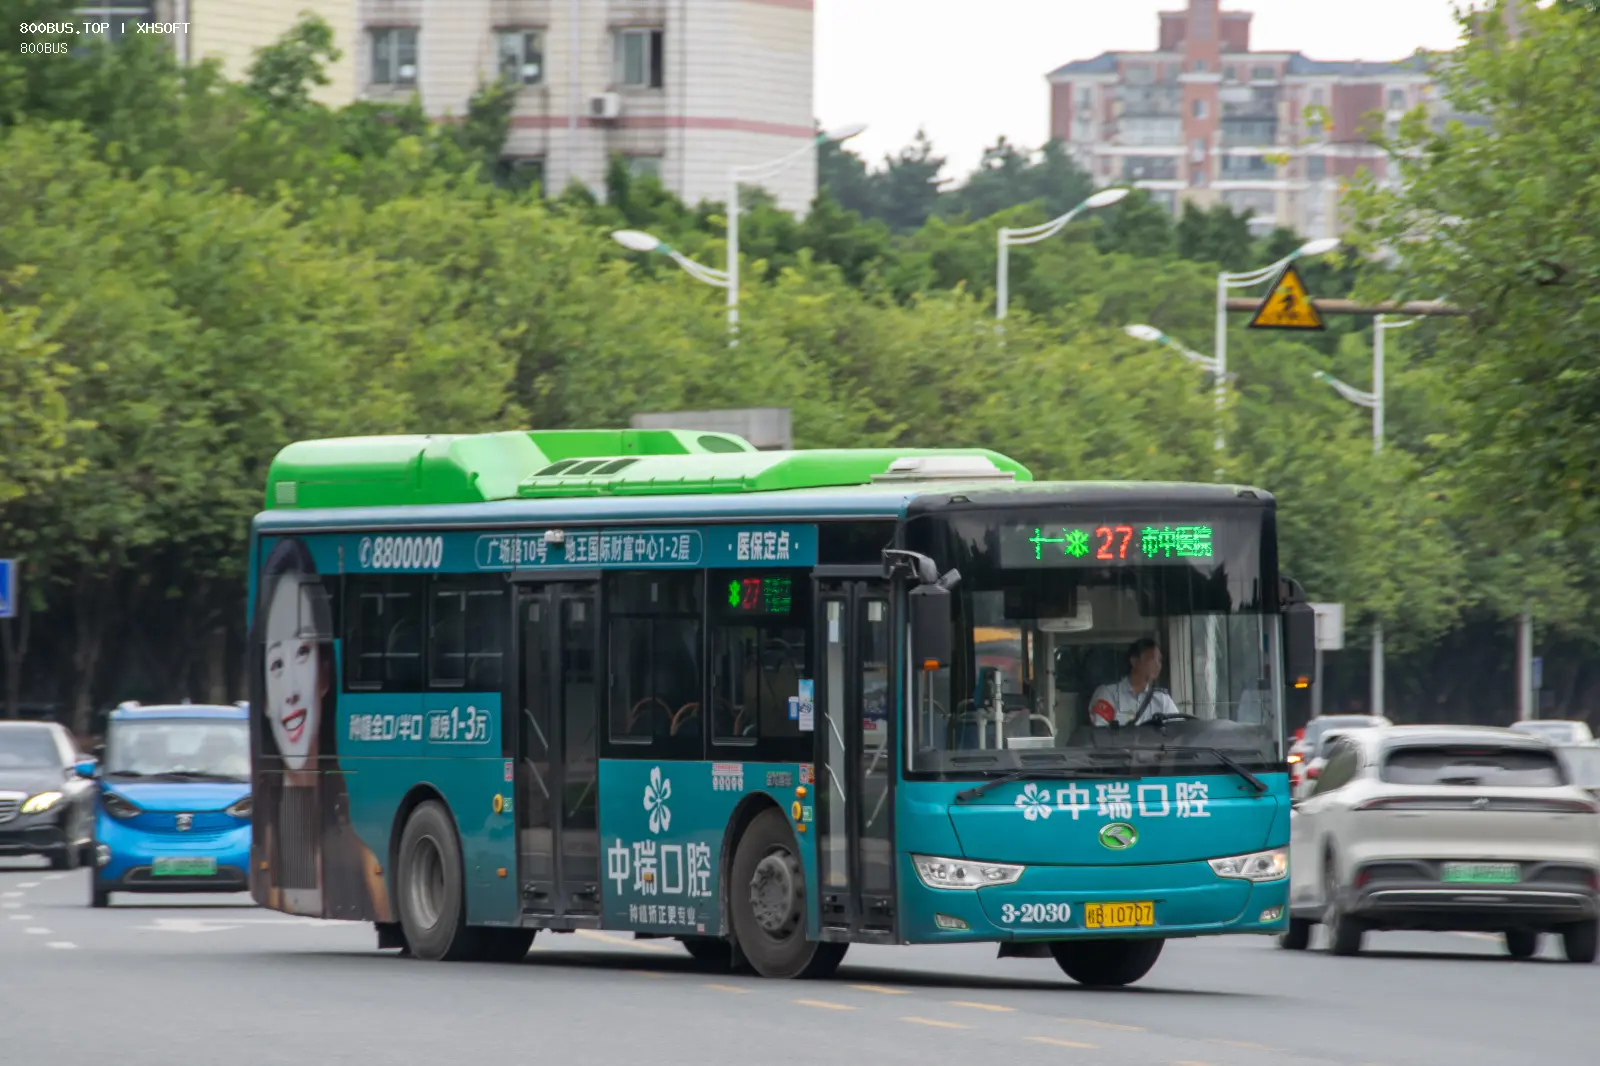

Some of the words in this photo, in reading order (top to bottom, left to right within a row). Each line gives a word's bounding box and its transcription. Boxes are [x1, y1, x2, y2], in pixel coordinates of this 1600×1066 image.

[371, 536, 444, 569] 8800000
[486, 537, 548, 565] 广场路10号
[736, 530, 790, 561] 医保定点
[1096, 525, 1133, 560] 27
[743, 578, 761, 610] 27
[1056, 782, 1210, 820] 中瑞口腔
[608, 838, 712, 897] 中瑞口腔
[1000, 902, 1072, 924] 3-2030
